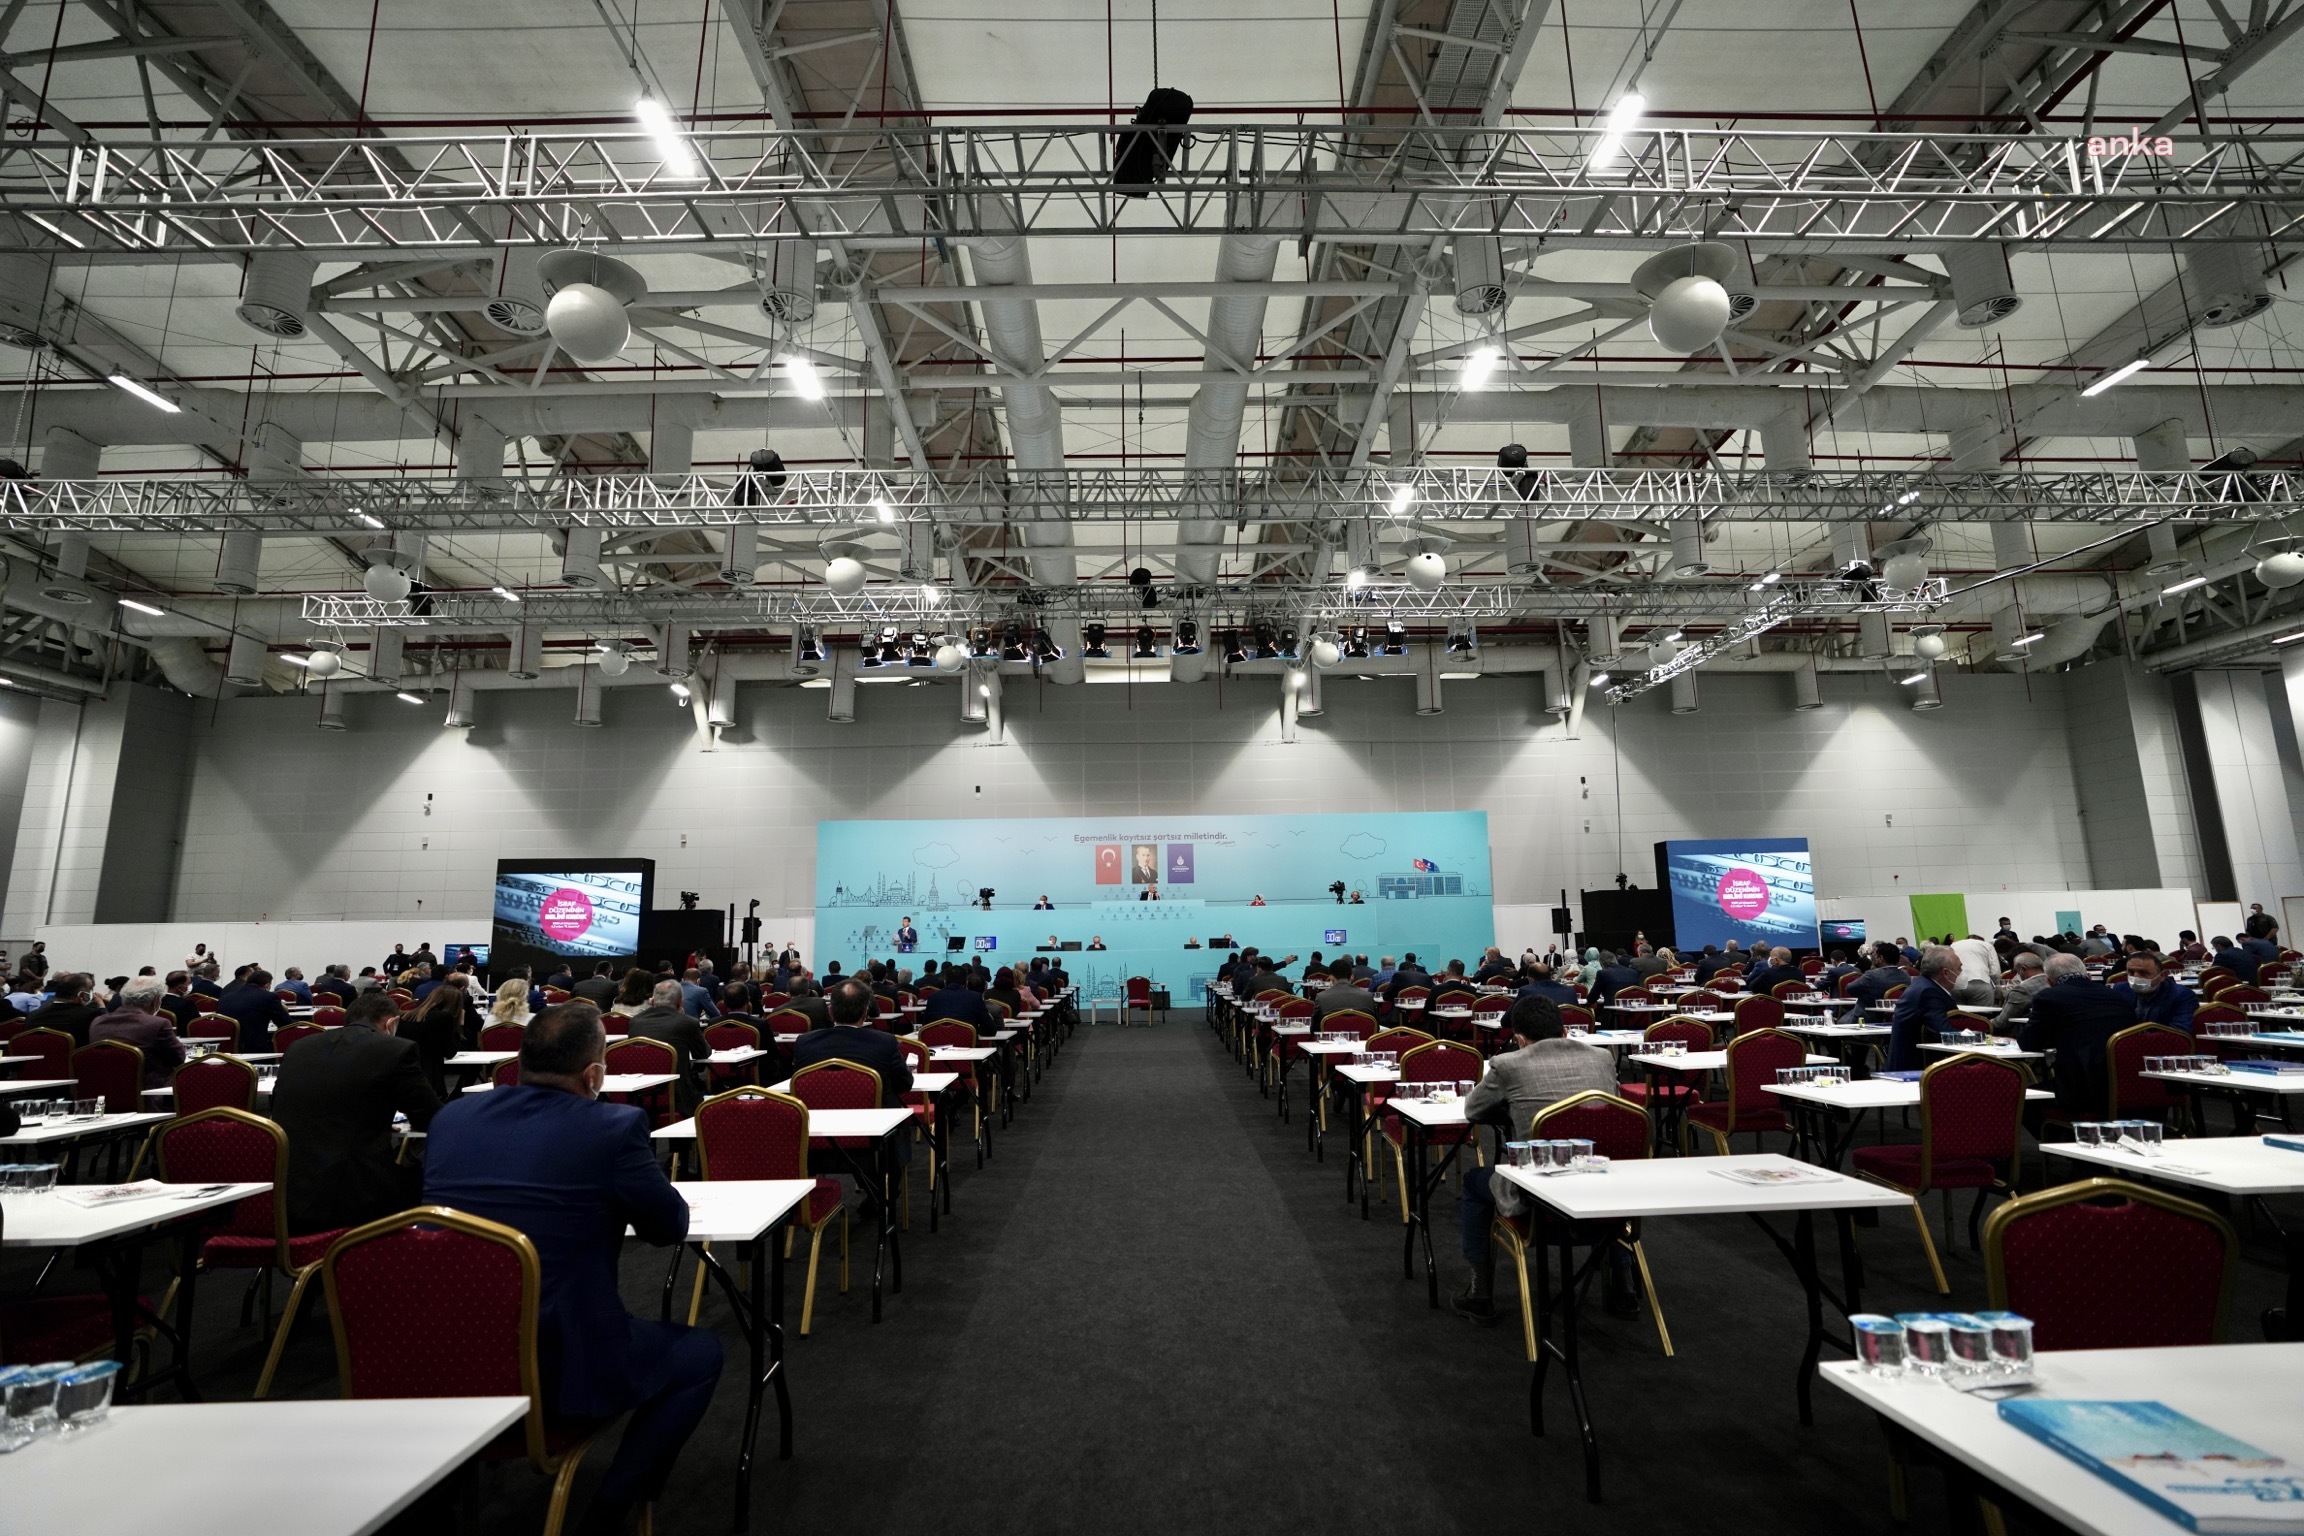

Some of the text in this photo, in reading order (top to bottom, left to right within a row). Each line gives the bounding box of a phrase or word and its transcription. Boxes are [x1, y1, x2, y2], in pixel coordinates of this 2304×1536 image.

[1074, 832, 1228, 843] Egemenlik kayıtsız şartsız milletindir.
